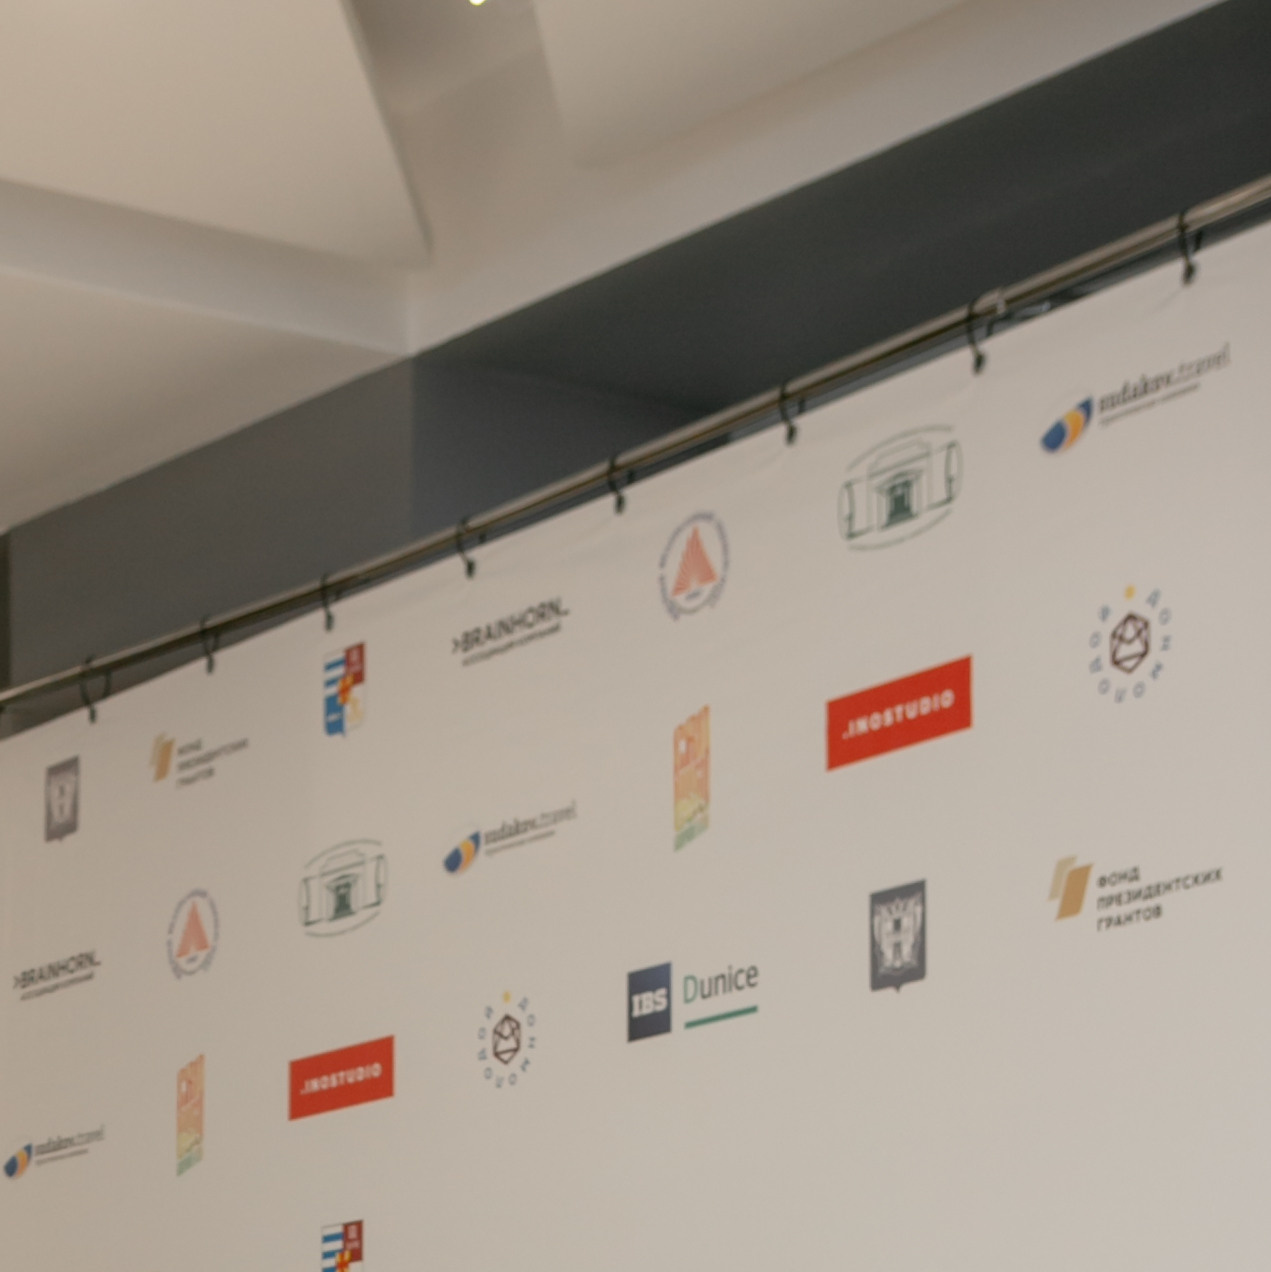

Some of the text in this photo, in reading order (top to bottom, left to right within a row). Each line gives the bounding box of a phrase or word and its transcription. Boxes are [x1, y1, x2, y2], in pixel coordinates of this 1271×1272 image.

[1097, 866, 1140, 888] ФОНД
[1097, 867, 1223, 911] ПРЕЗИДЕНТСКИХ
[1097, 904, 1162, 932] ГРАНТОВ
[632, 964, 759, 1018] IBS Dunice
